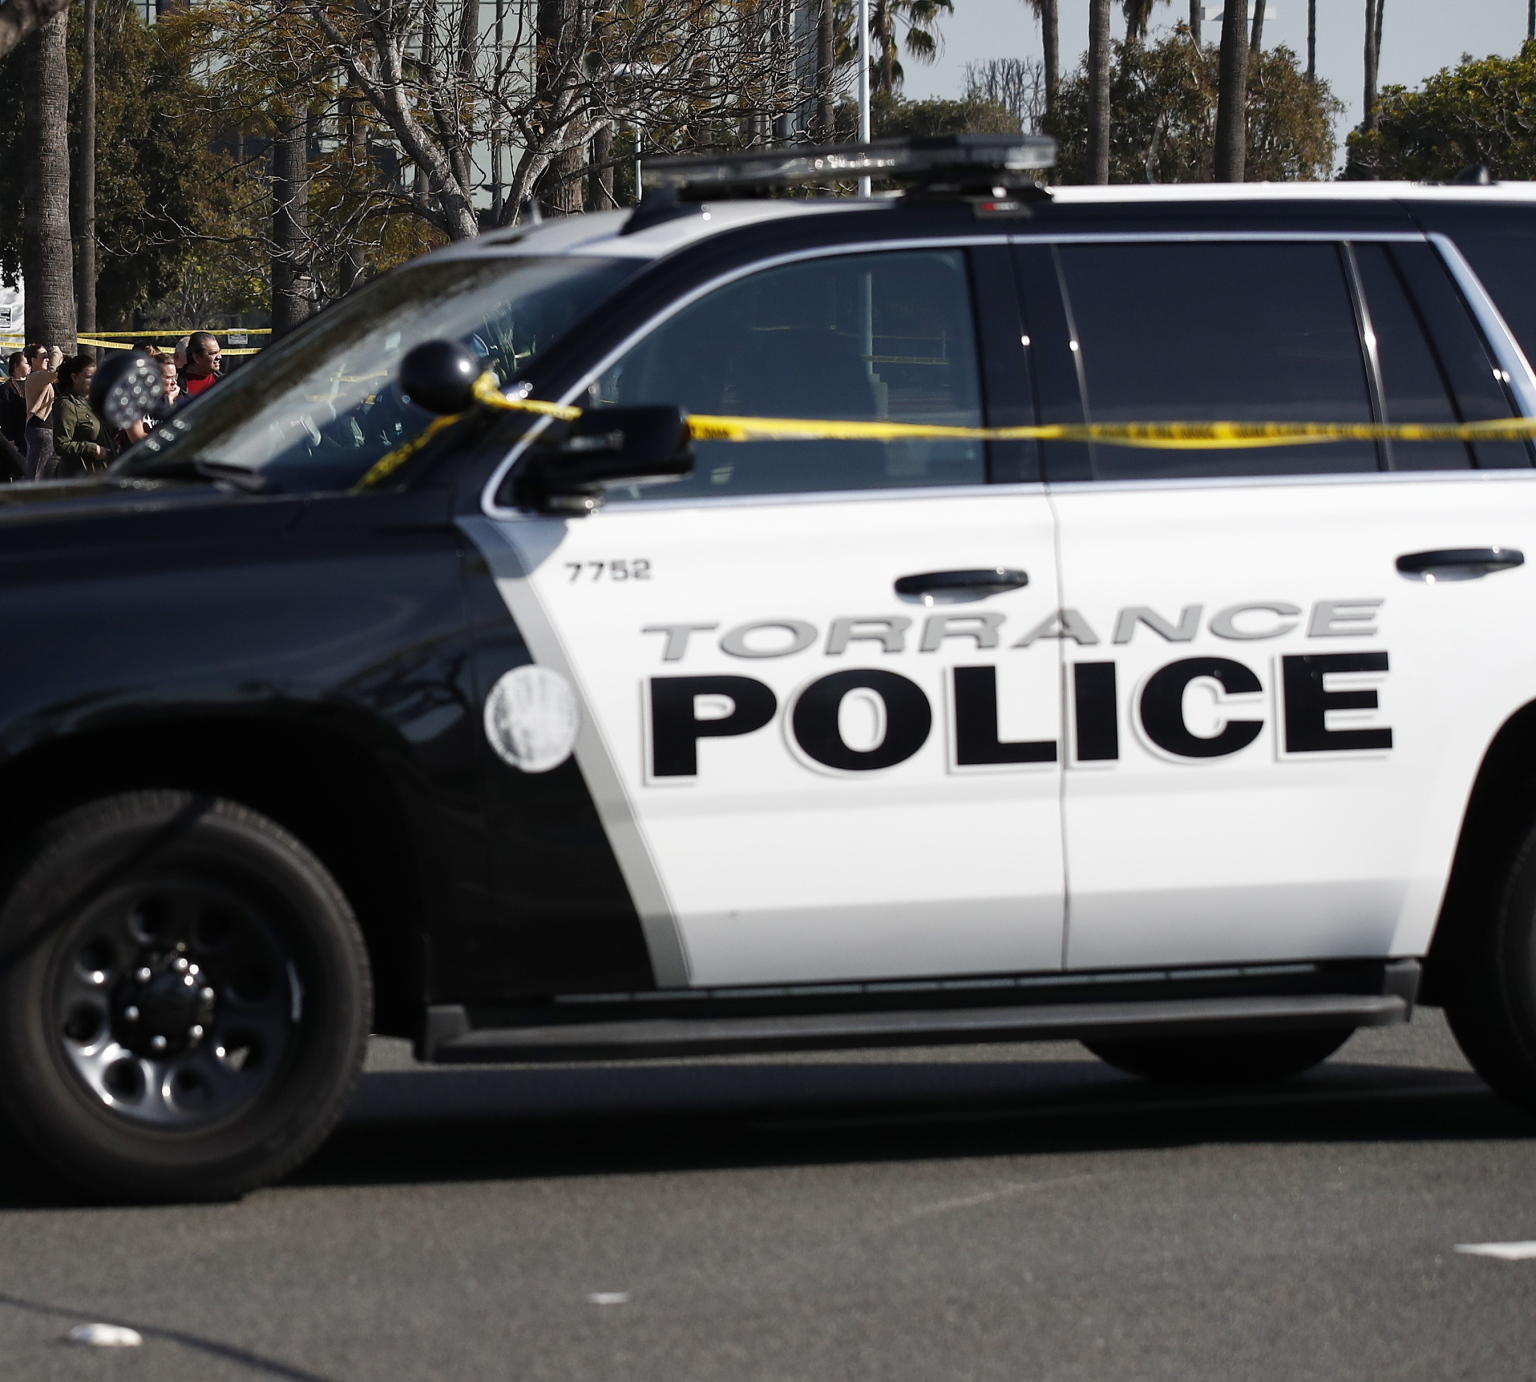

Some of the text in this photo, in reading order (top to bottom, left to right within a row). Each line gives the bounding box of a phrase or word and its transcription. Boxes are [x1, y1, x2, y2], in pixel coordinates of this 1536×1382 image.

[565, 558, 651, 583] 7752
[642, 599, 1385, 661] TORRANCE
[644, 651, 1394, 783] POLICE
